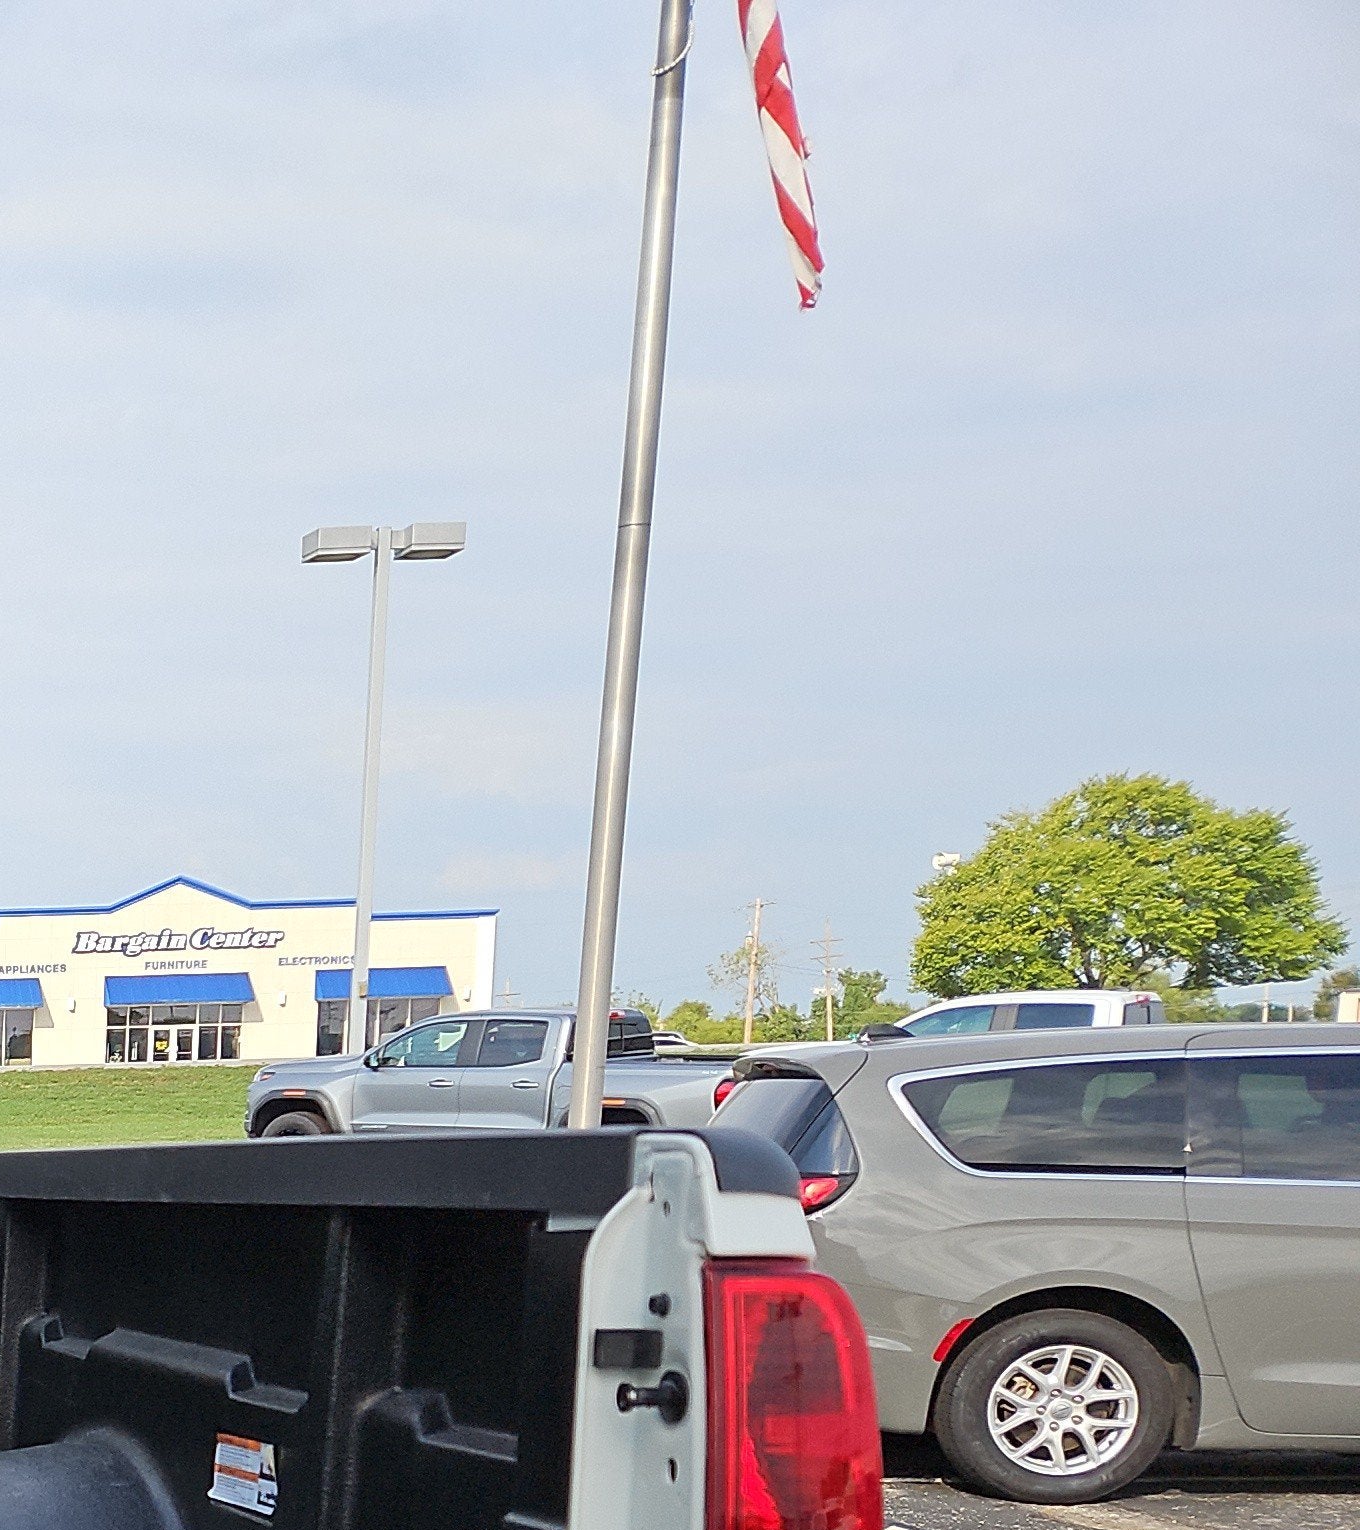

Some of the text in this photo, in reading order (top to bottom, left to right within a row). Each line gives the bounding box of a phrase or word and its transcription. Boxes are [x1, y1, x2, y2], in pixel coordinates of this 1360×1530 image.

[71, 927, 284, 957] Bargain Center
[144, 959, 209, 971] FURNITURE
